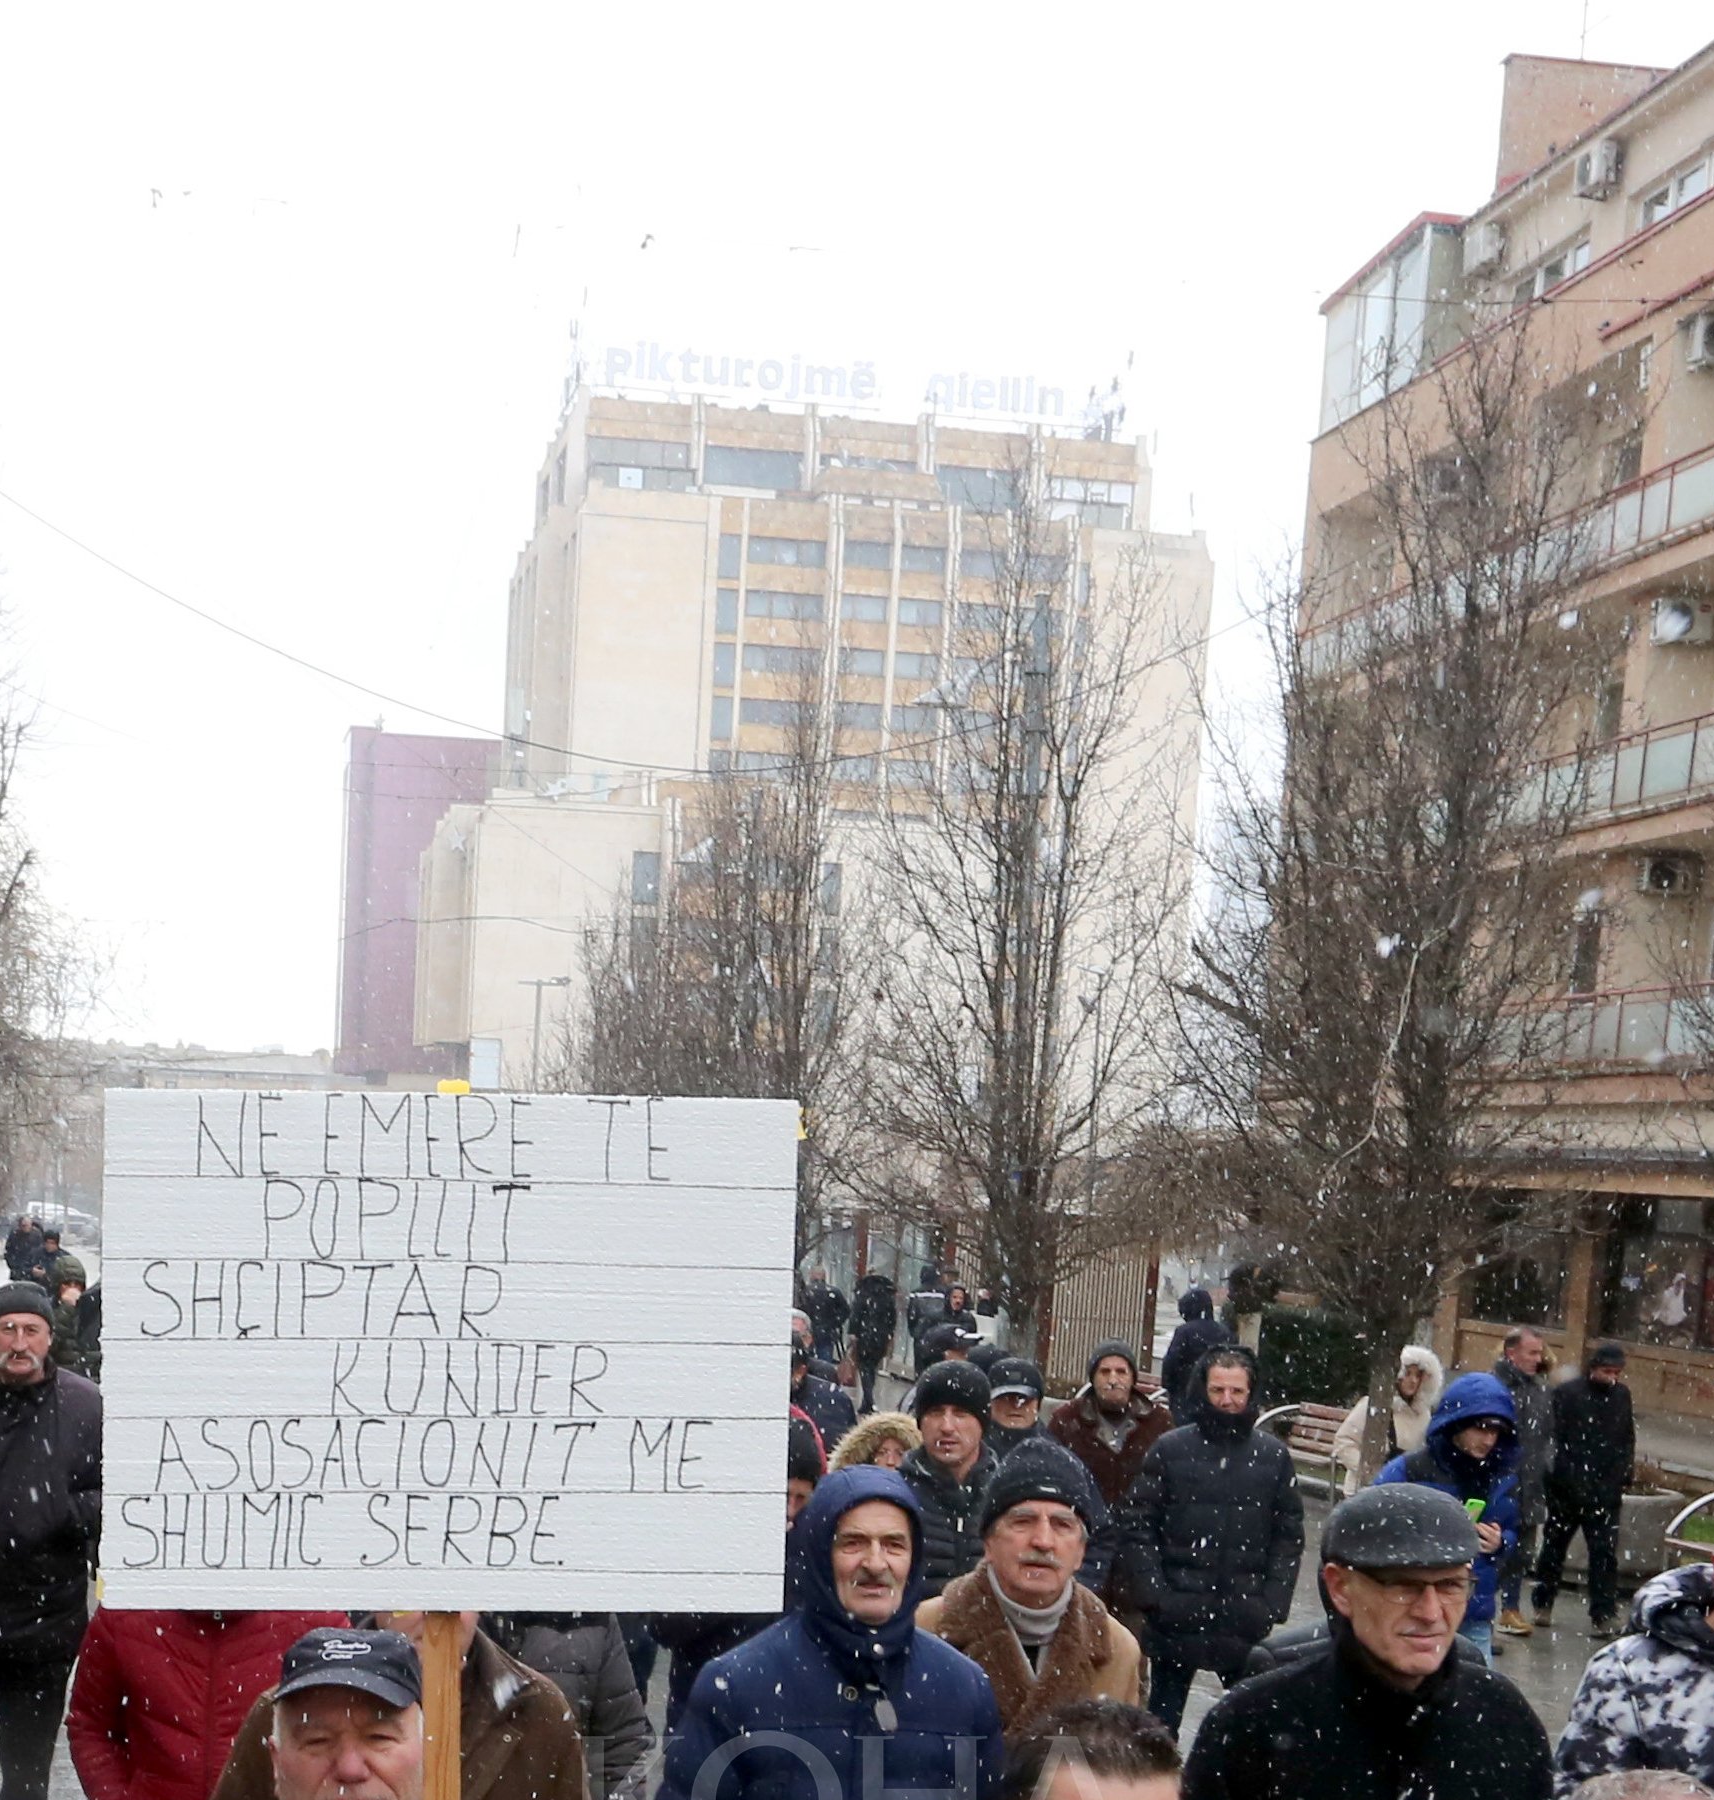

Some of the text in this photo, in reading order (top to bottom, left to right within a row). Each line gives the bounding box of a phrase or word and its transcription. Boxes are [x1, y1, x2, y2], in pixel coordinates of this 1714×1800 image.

[604, 341, 878, 400] pikturojmë
[332, 1340, 608, 1418] KUNDER
[155, 1418, 713, 1492] ASOSACIONIT ME
[121, 1493, 323, 1569] SHUMIC
